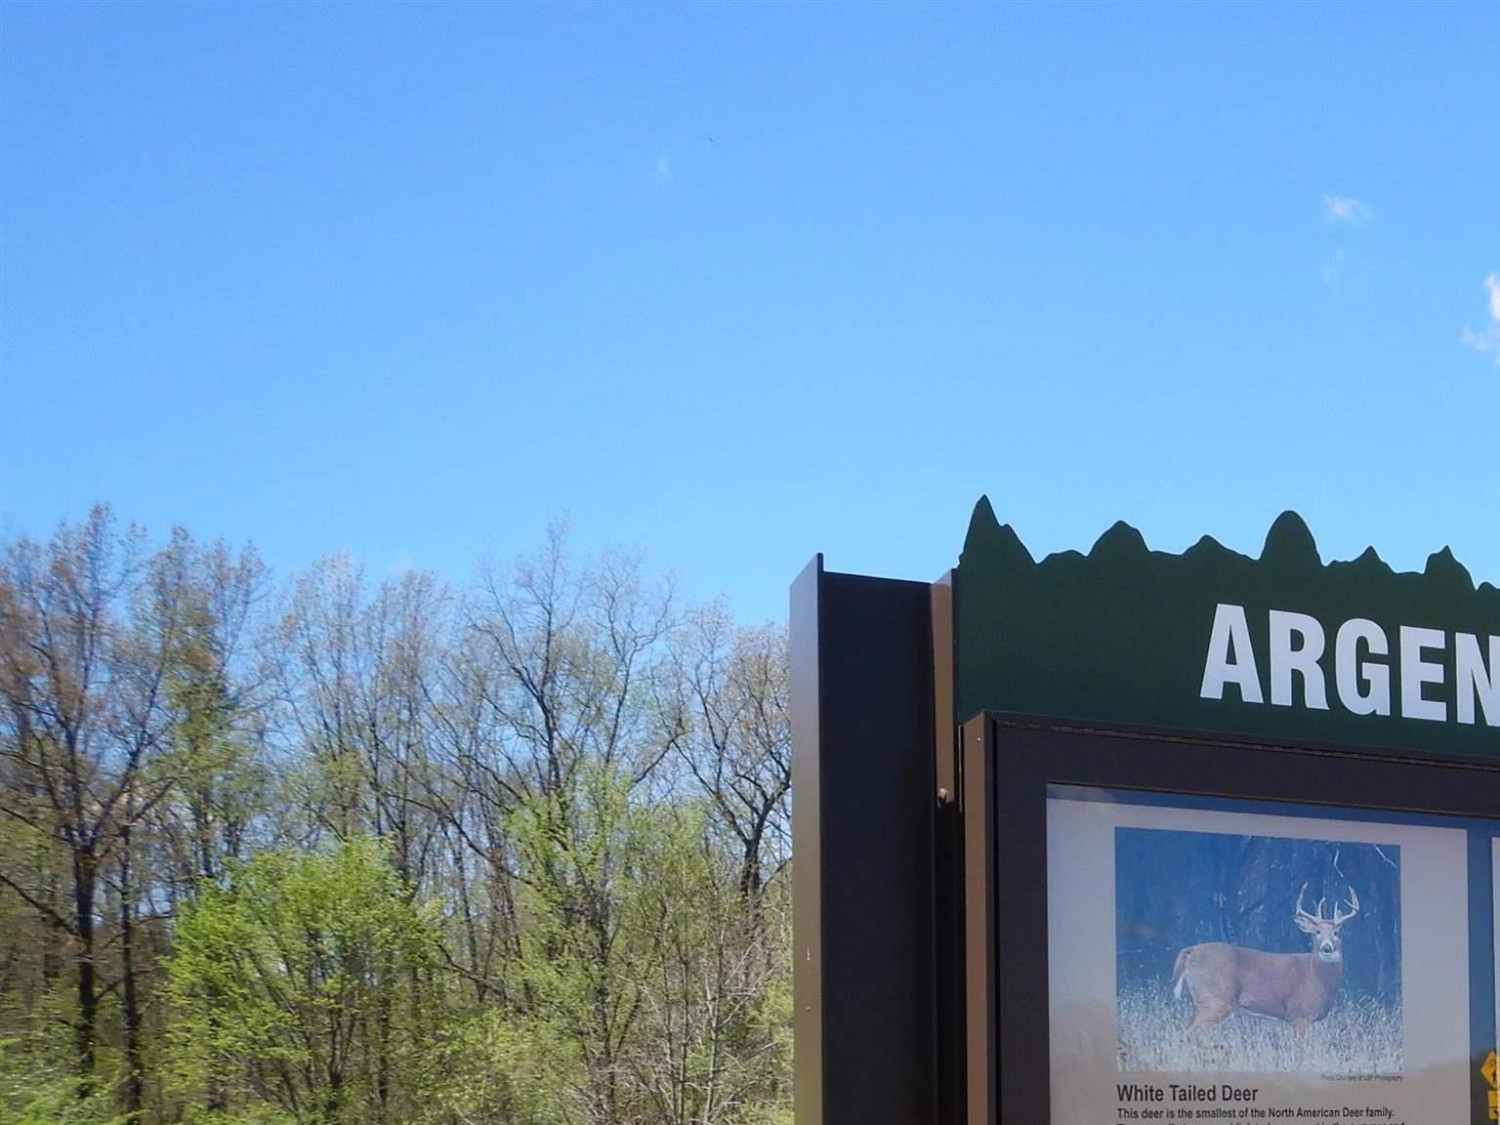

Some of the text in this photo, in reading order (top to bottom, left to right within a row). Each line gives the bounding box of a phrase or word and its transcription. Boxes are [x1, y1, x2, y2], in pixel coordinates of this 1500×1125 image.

[1116, 1084, 1258, 1101] White Tailed Deer
[1117, 1109, 1138, 1118] This
[1140, 1109, 1163, 1118] deer
[1166, 1109, 1174, 1118] is
[1177, 1108, 1193, 1118] the
[1195, 1108, 1236, 1118] smallest
[1238, 1108, 1248, 1117] of
[1250, 1108, 1265, 1117] the
[1268, 1108, 1294, 1117] North
[1296, 1108, 1340, 1117] American
[1342, 1107, 1363, 1117] Deer
